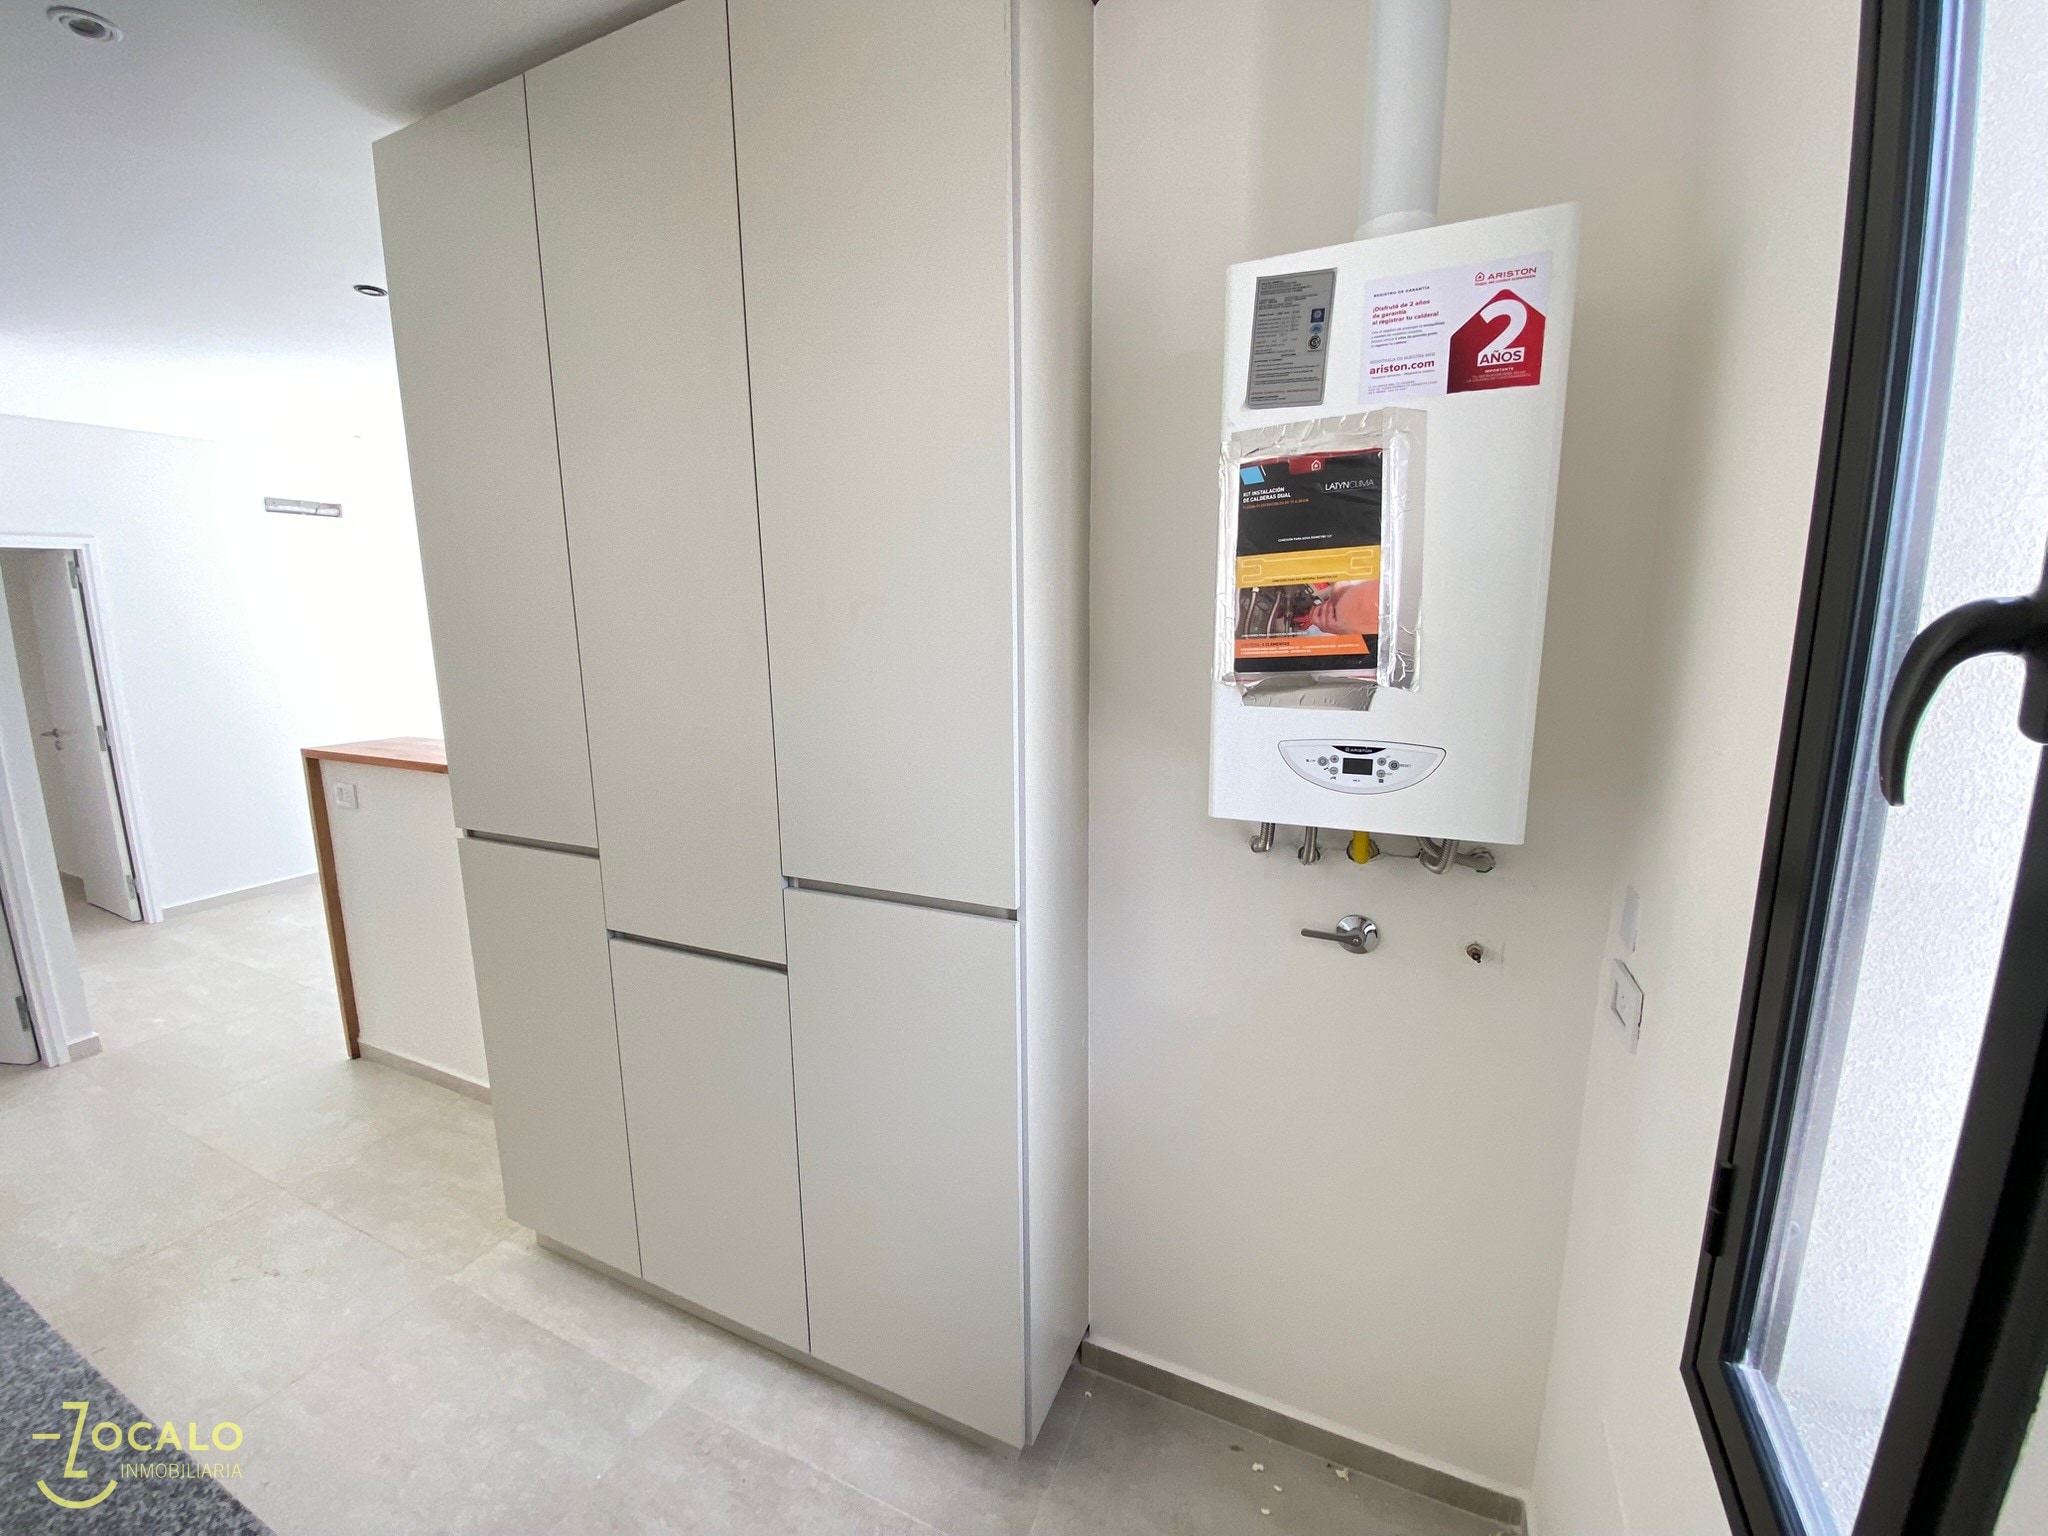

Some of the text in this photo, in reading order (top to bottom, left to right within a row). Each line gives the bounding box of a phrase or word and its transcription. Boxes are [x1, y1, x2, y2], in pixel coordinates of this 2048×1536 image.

[1487, 267, 1537, 280] ARISTON
[1372, 303, 1399, 313] ¡Disfrutá
[1381, 310, 1407, 319] garantía
[1378, 316, 1405, 325] registrar
[1414, 311, 1440, 320] caldera!
[1478, 299, 1527, 356] 2
[1479, 350, 1522, 365] AÑOS
[1369, 360, 1435, 375] ariston.com
[1250, 494, 1277, 502] CALDERAS
[1251, 487, 1285, 496] INSTALACIÓN
